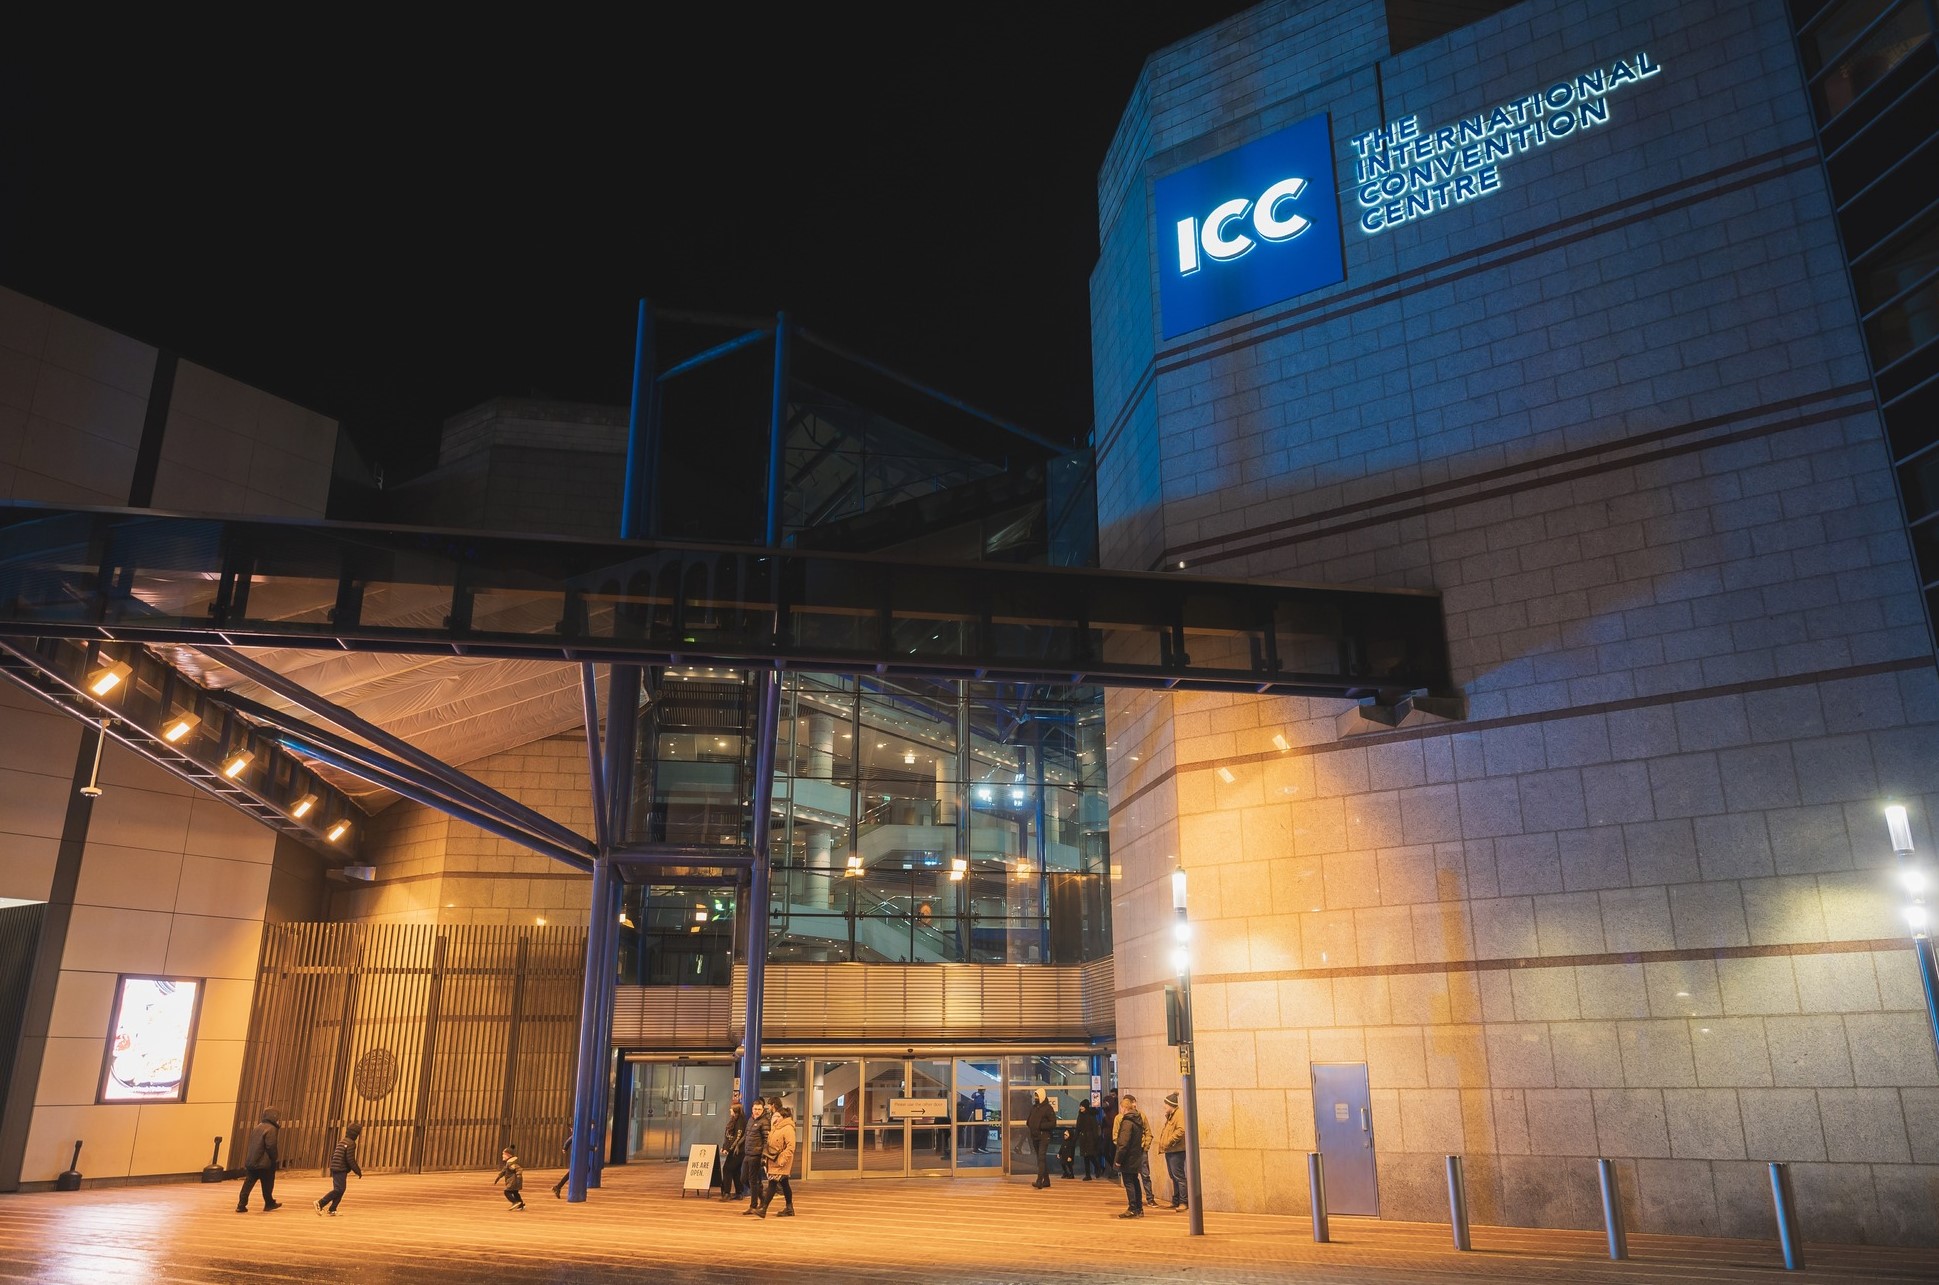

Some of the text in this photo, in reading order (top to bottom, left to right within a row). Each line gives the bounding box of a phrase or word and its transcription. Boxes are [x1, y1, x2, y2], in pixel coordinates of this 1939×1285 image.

[1352, 115, 1418, 157] THE
[1356, 52, 1661, 183] INTERNATIONAL
[1359, 97, 1609, 207] CONVENTION
[1177, 177, 1312, 277] ICC
[1361, 165, 1501, 233] CENTRE
[691, 1161, 710, 1169] WE ARE
